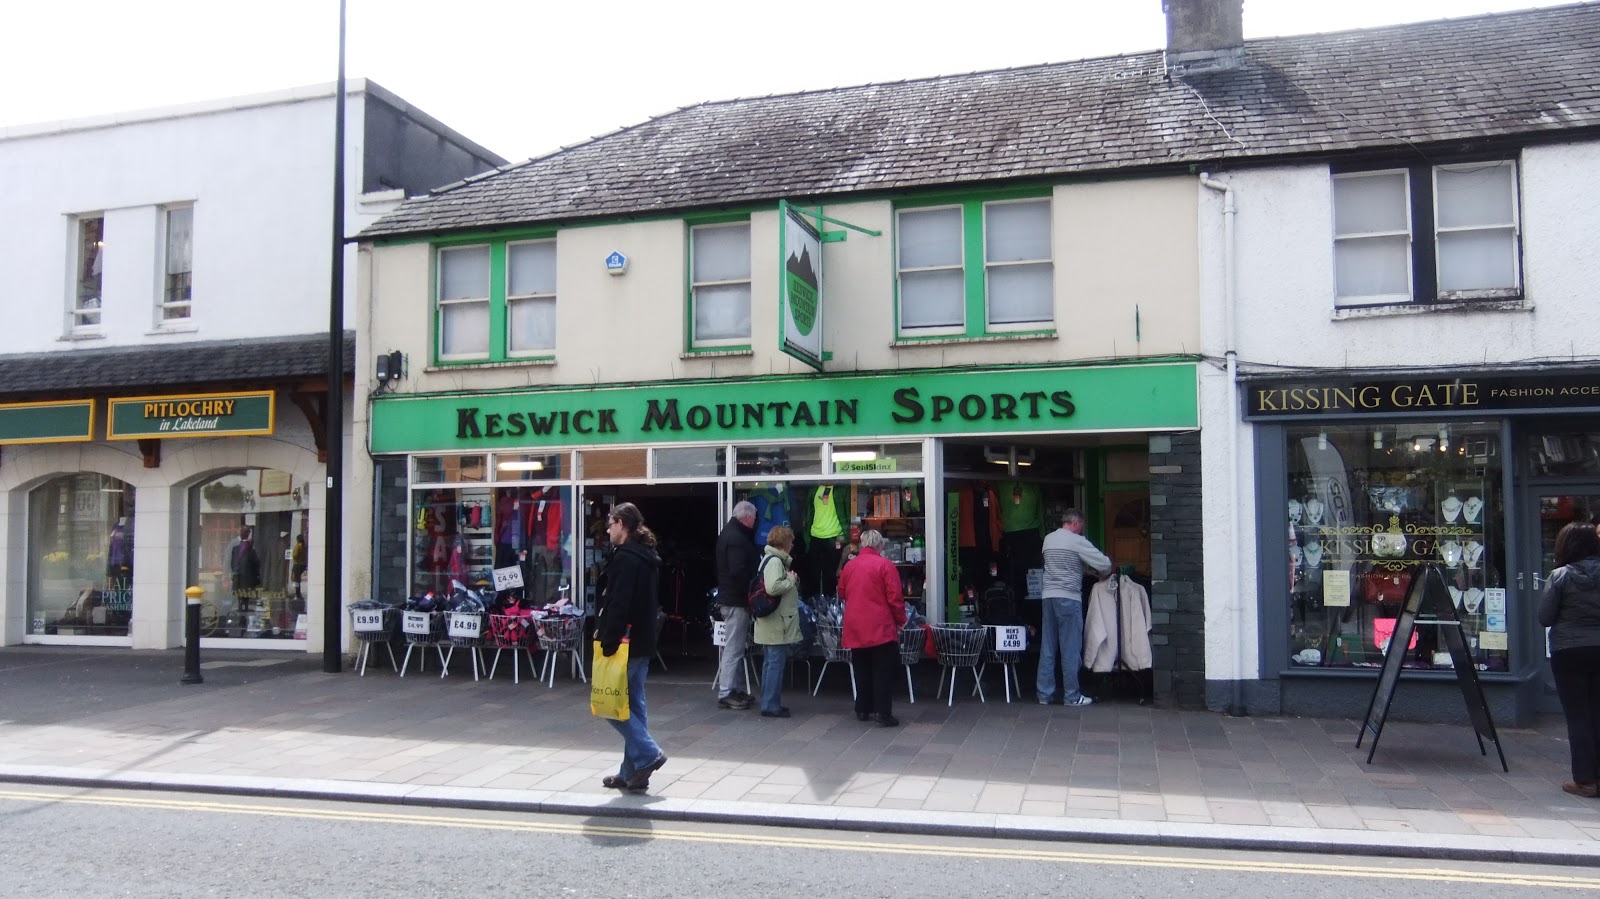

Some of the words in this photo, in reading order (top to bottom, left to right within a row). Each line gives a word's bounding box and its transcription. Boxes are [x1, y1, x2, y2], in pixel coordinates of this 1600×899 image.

[1257, 387, 1382, 411] KISSING
[1390, 383, 1480, 408] GATE
[1490, 388, 1555, 397] FASHION
[143, 399, 235, 418] PITLOCHRY
[456, 407, 619, 439] KESWICK
[641, 398, 859, 432] MOUNTAIN
[891, 387, 1076, 423] SPORTS
[159, 419, 171, 431] in
[171, 416, 220, 431] Lakeland
[497, 572, 519, 583] £4.99
[356, 614, 380, 624] £9.99
[453, 621, 478, 631] £4.99
[1003, 640, 1021, 648] £4.99
